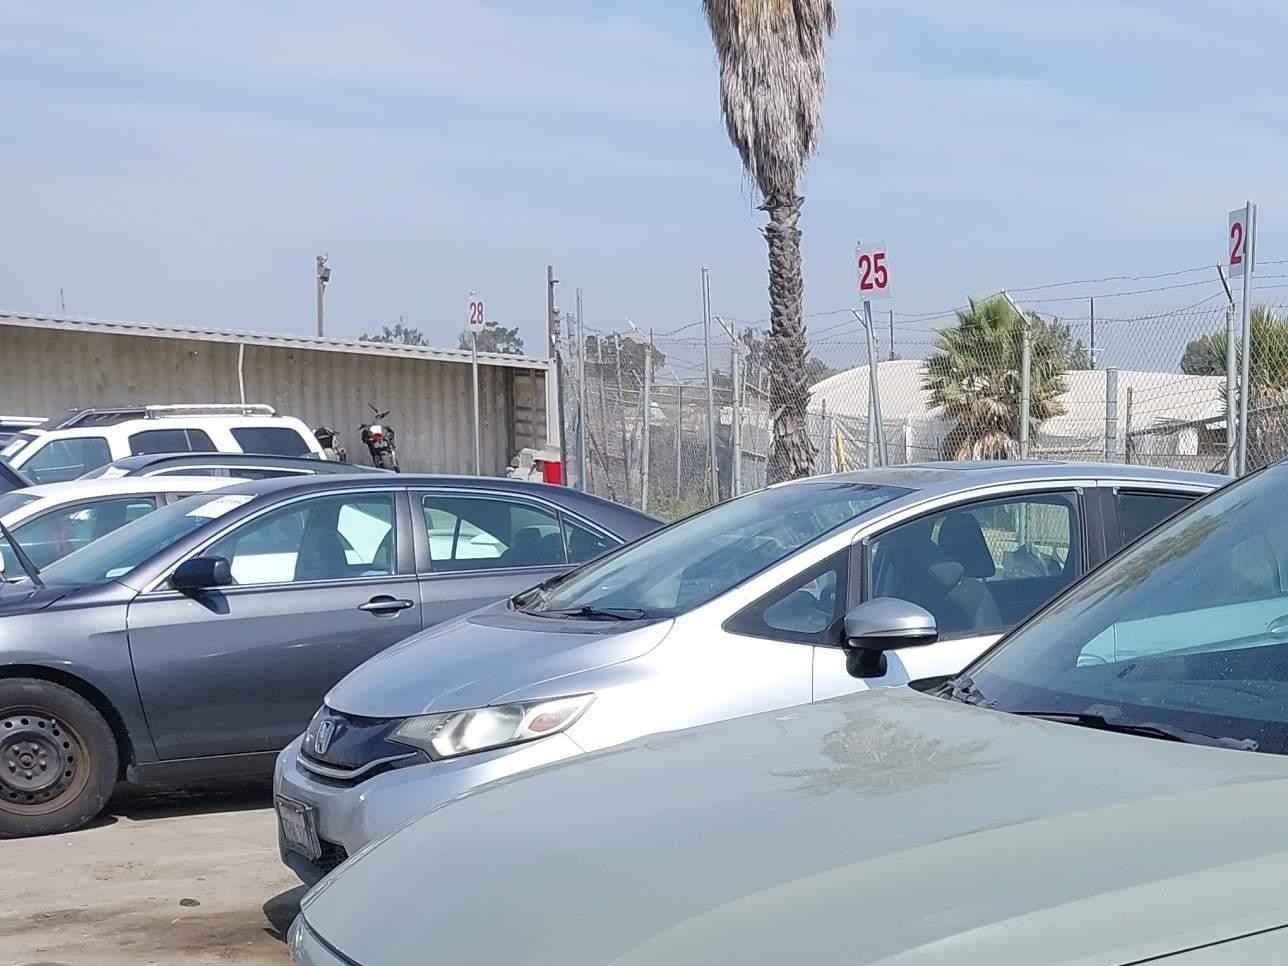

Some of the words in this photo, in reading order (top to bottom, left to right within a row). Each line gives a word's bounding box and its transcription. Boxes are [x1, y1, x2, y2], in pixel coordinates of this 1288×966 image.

[1230, 221, 1247, 265] 2
[858, 252, 888, 291] 25
[470, 301, 484, 325] 28
